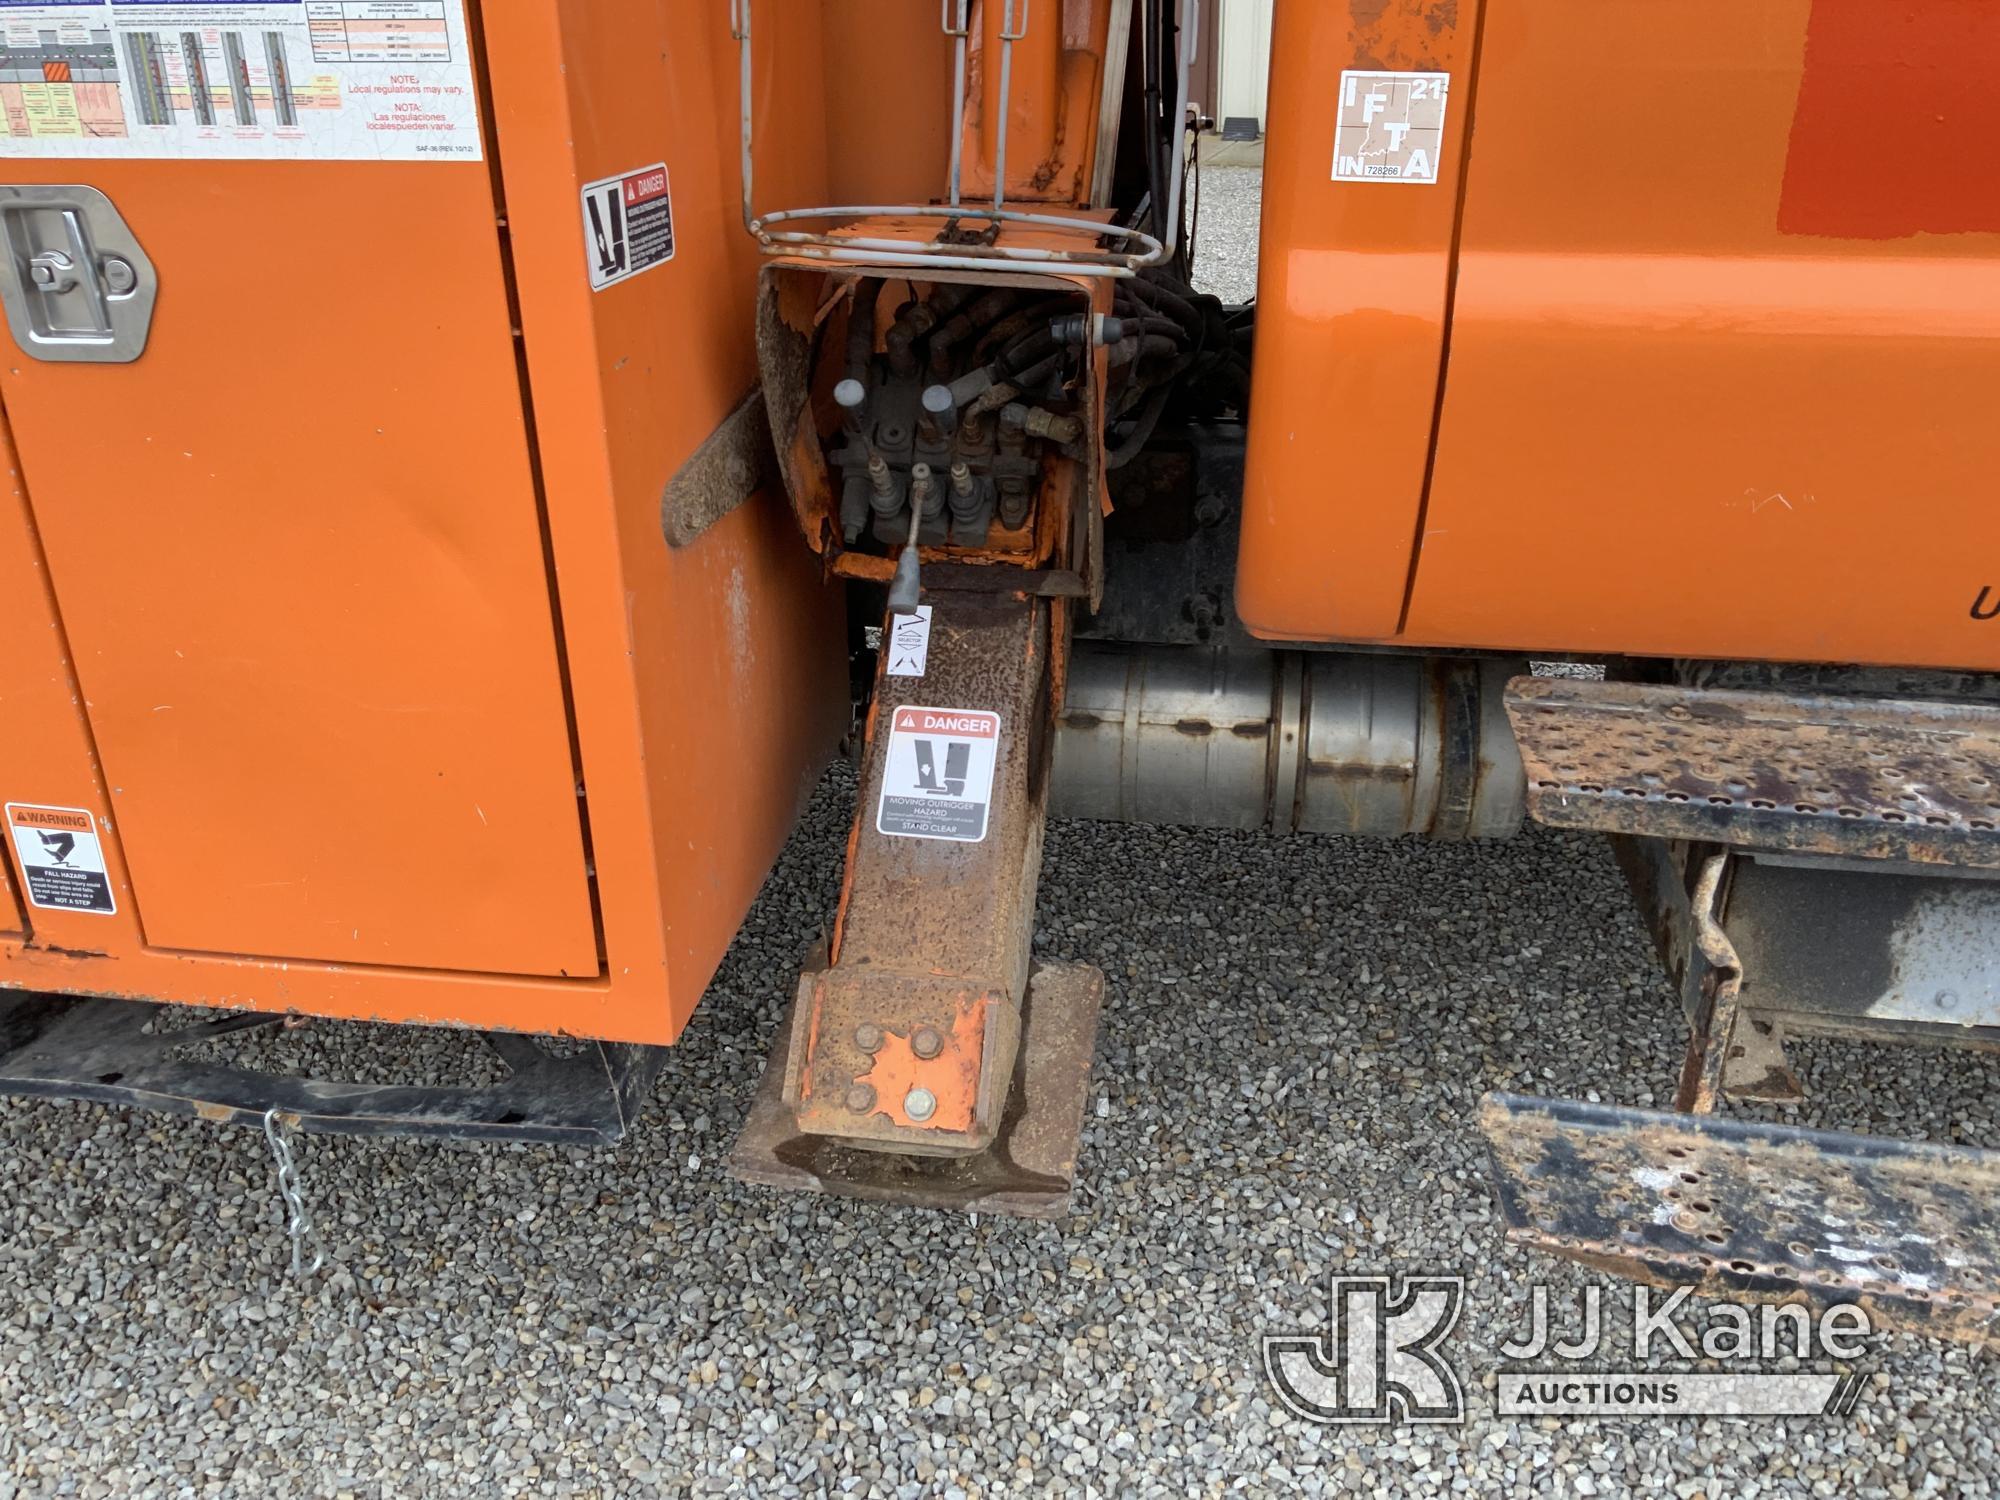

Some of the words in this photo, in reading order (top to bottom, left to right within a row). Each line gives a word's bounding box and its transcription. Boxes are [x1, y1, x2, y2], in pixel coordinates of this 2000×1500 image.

[374, 85, 421, 95] regulations
[1410, 79, 1442, 100] 21
[392, 113, 446, 122] regulaciones
[1339, 156, 1364, 176] IN
[1367, 167, 1398, 176] 728266
[638, 174, 664, 196] DANGER
[924, 716, 991, 733] DANGER
[889, 798, 925, 806] MOVING
[928, 800, 974, 810] OUTRIGGER
[914, 808, 947, 816] HAZARD
[27, 812, 87, 827] WARNING
[902, 822, 928, 830] STAND
[930, 824, 957, 832] CLEAR
